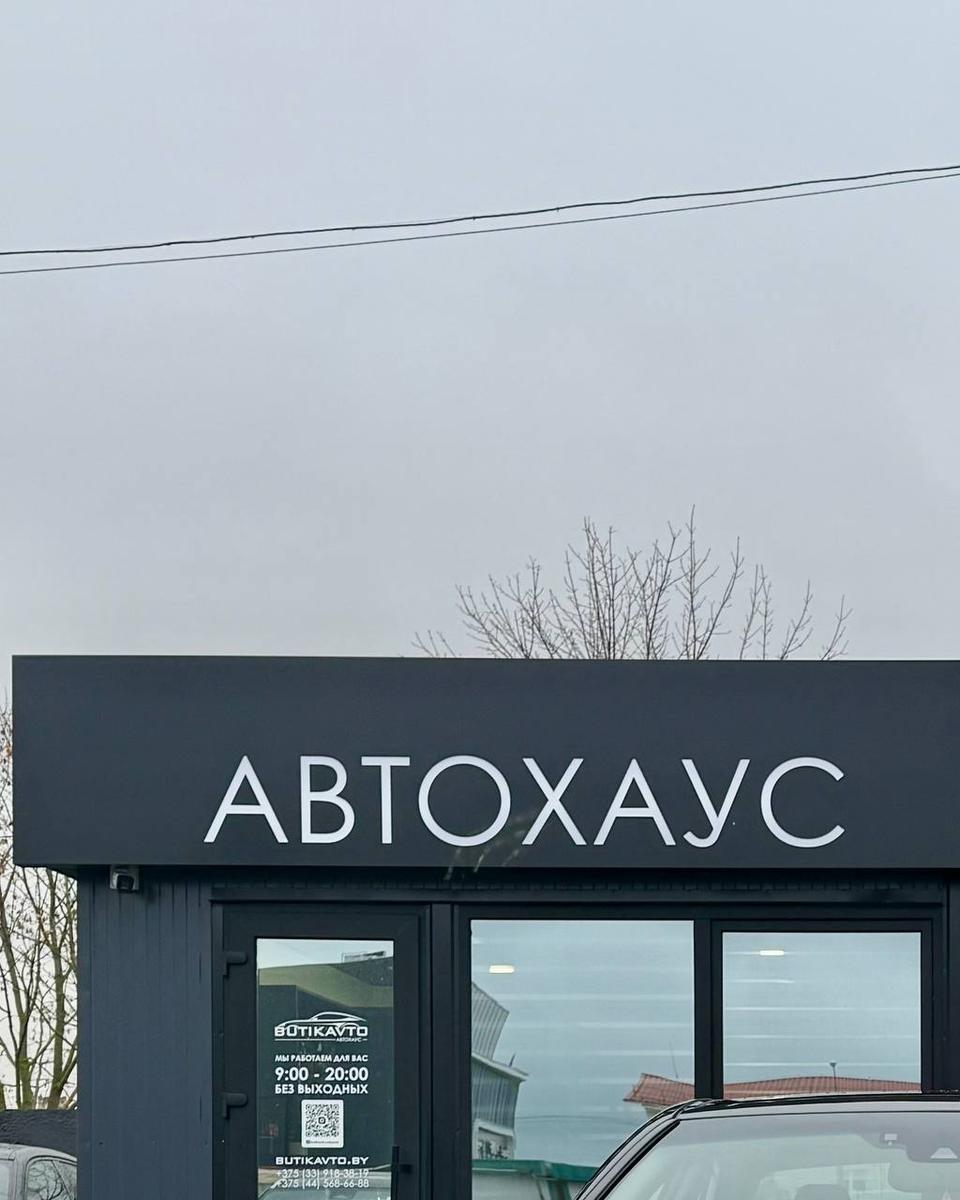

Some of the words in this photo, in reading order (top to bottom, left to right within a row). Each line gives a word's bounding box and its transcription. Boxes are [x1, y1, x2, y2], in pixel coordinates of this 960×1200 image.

[204, 754, 846, 848] АВТОХАУС
[274, 1026, 368, 1037] BUTIKAVTO
[275, 1066, 309, 1081] 9:00
[324, 1066, 369, 1081] 20:00
[275, 1084, 295, 1094] БЕЗ
[297, 1084, 369, 1095] ВЫХОДНЫХ
[275, 1156, 369, 1165] BUTIKAVTO.BY
[277, 1169, 299, 1178] +375
[302, 1169, 320, 1179] (33)
[323, 1169, 369, 1178] 918-38-19
[278, 1179, 299, 1188] +375
[302, 1179, 320, 1189] (44)
[323, 1179, 370, 1188] 568-66-88
